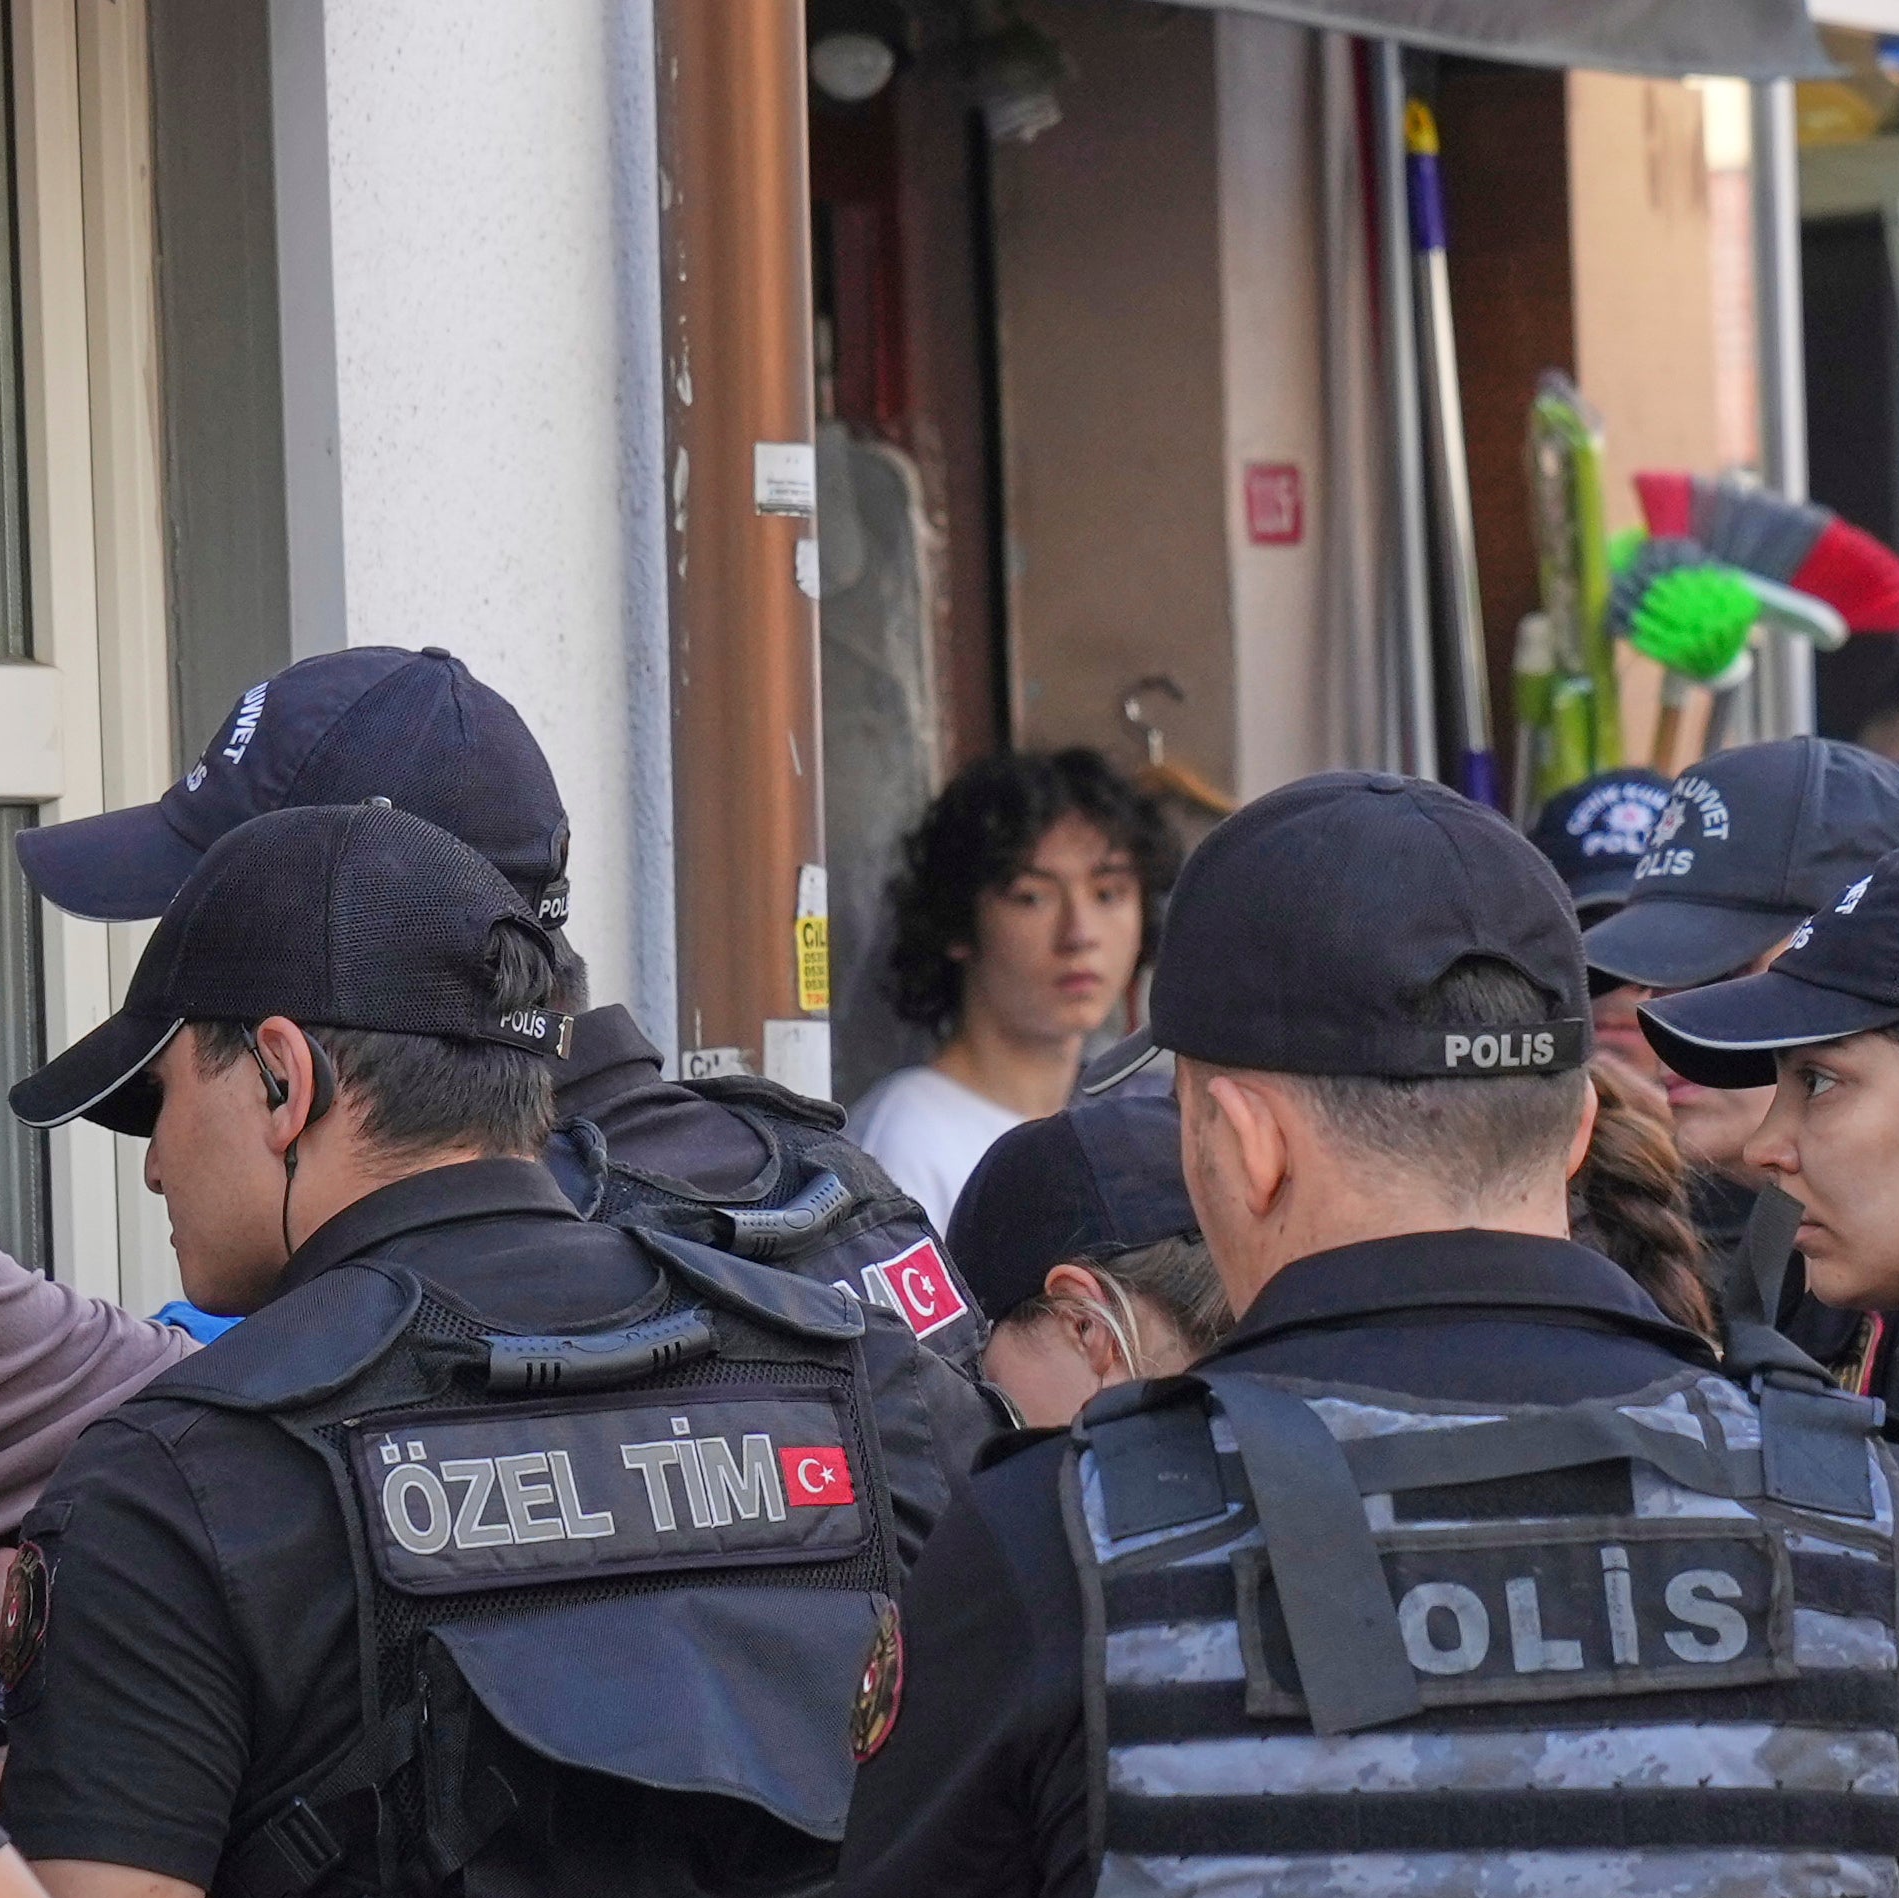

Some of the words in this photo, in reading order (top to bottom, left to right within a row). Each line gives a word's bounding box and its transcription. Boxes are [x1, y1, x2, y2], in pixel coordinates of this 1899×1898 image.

[222, 681, 270, 765] UVVET
[1634, 848, 1696, 881] OLİS
[538, 896, 569, 919] POL
[381, 1433, 615, 1555] ÖZEL
[620, 1416, 786, 1533] TİM
[1398, 1546, 1749, 1675] OLİS
